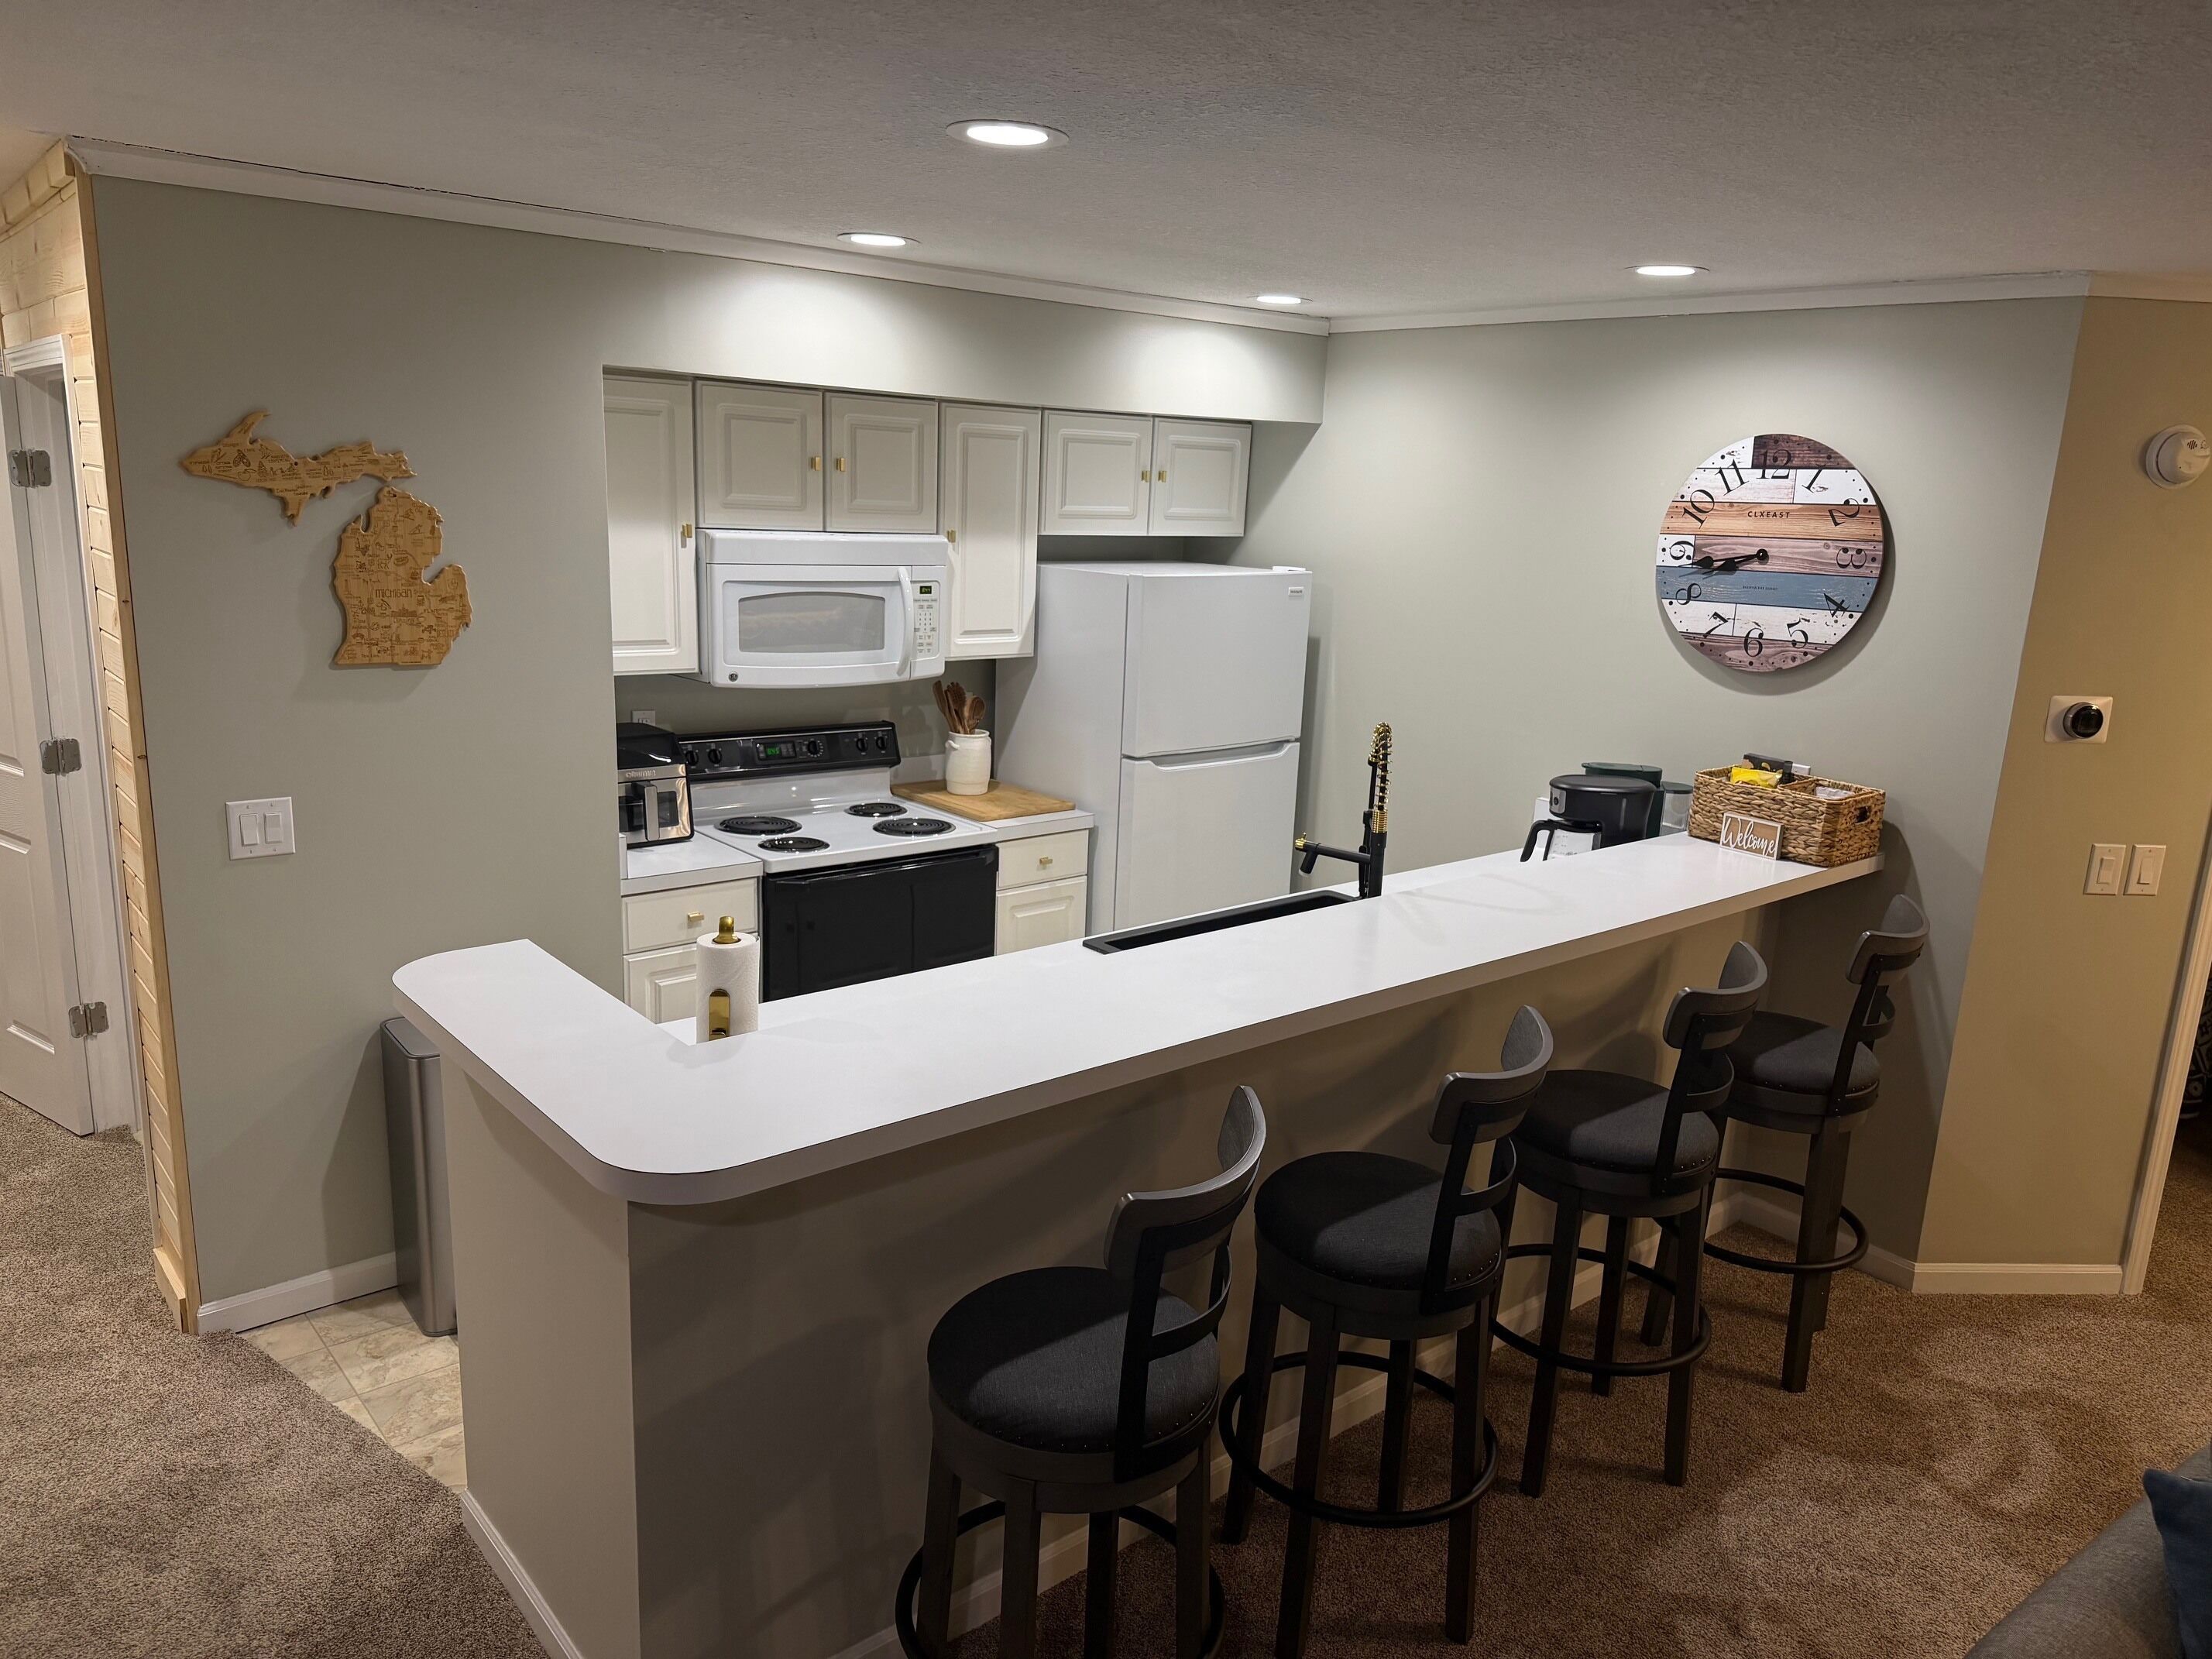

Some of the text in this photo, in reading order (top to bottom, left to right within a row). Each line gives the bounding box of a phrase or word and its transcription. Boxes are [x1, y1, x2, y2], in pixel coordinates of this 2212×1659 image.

[1714, 459, 1750, 496] 11
[1756, 448, 1792, 479] 12
[1802, 463, 1826, 493] 1
[1682, 489, 1716, 529] 10
[1828, 497, 1860, 527] 2
[1669, 541, 1695, 561] 9
[1836, 547, 1867, 569] 3
[1675, 582, 1702, 606] 8
[1822, 592, 1851, 618] 4
[1703, 611, 1728, 638] 7
[1786, 617, 1808, 648] 5
[1743, 627, 1764, 657] 6
[1723, 817, 1777, 857] Welcome
